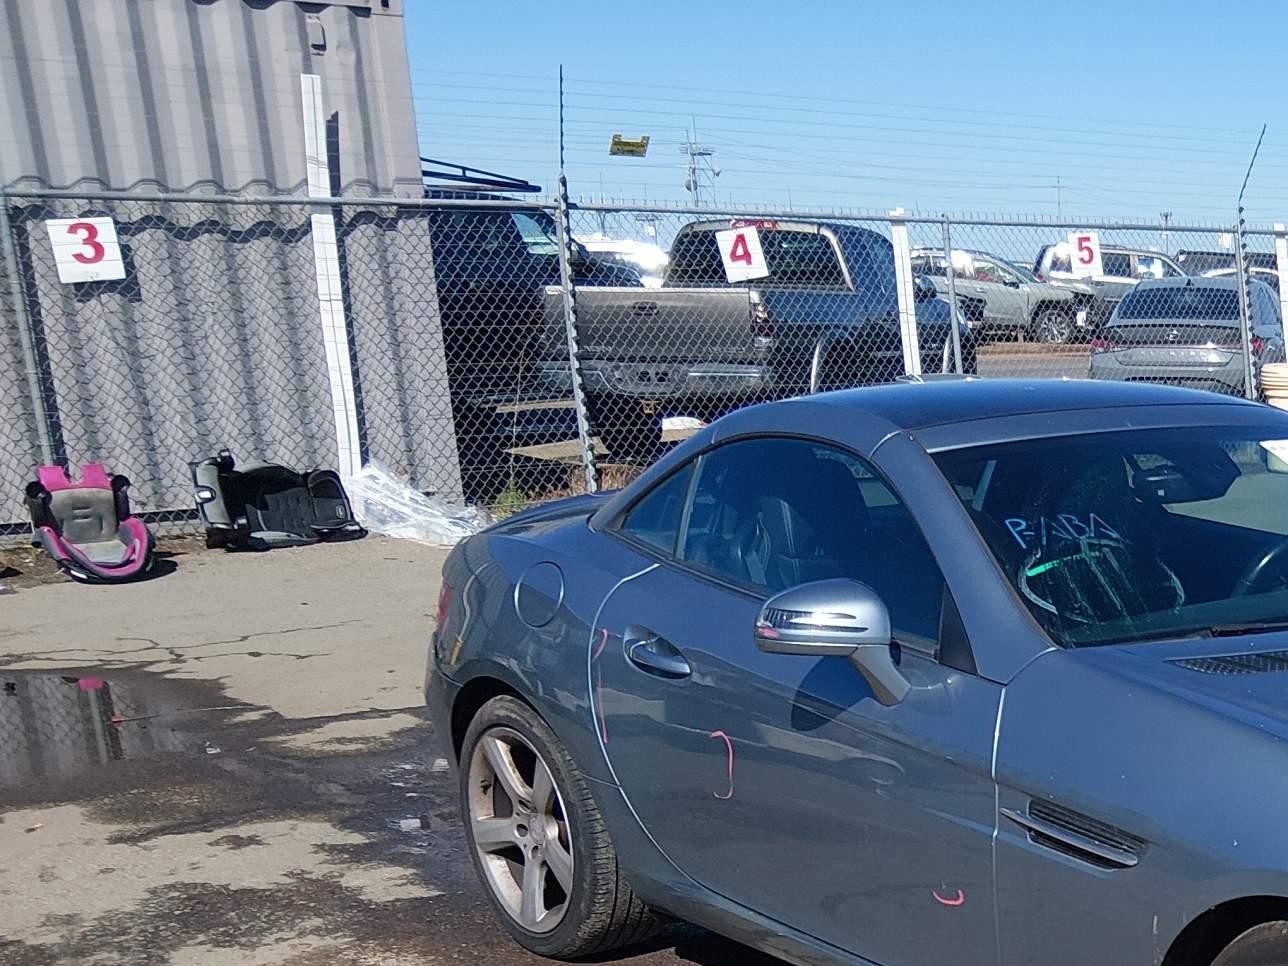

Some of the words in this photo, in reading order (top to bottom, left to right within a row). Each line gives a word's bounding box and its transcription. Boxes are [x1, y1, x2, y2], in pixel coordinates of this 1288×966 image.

[67, 222, 105, 265] 3
[729, 233, 753, 265] 4
[1077, 235, 1093, 265] 5
